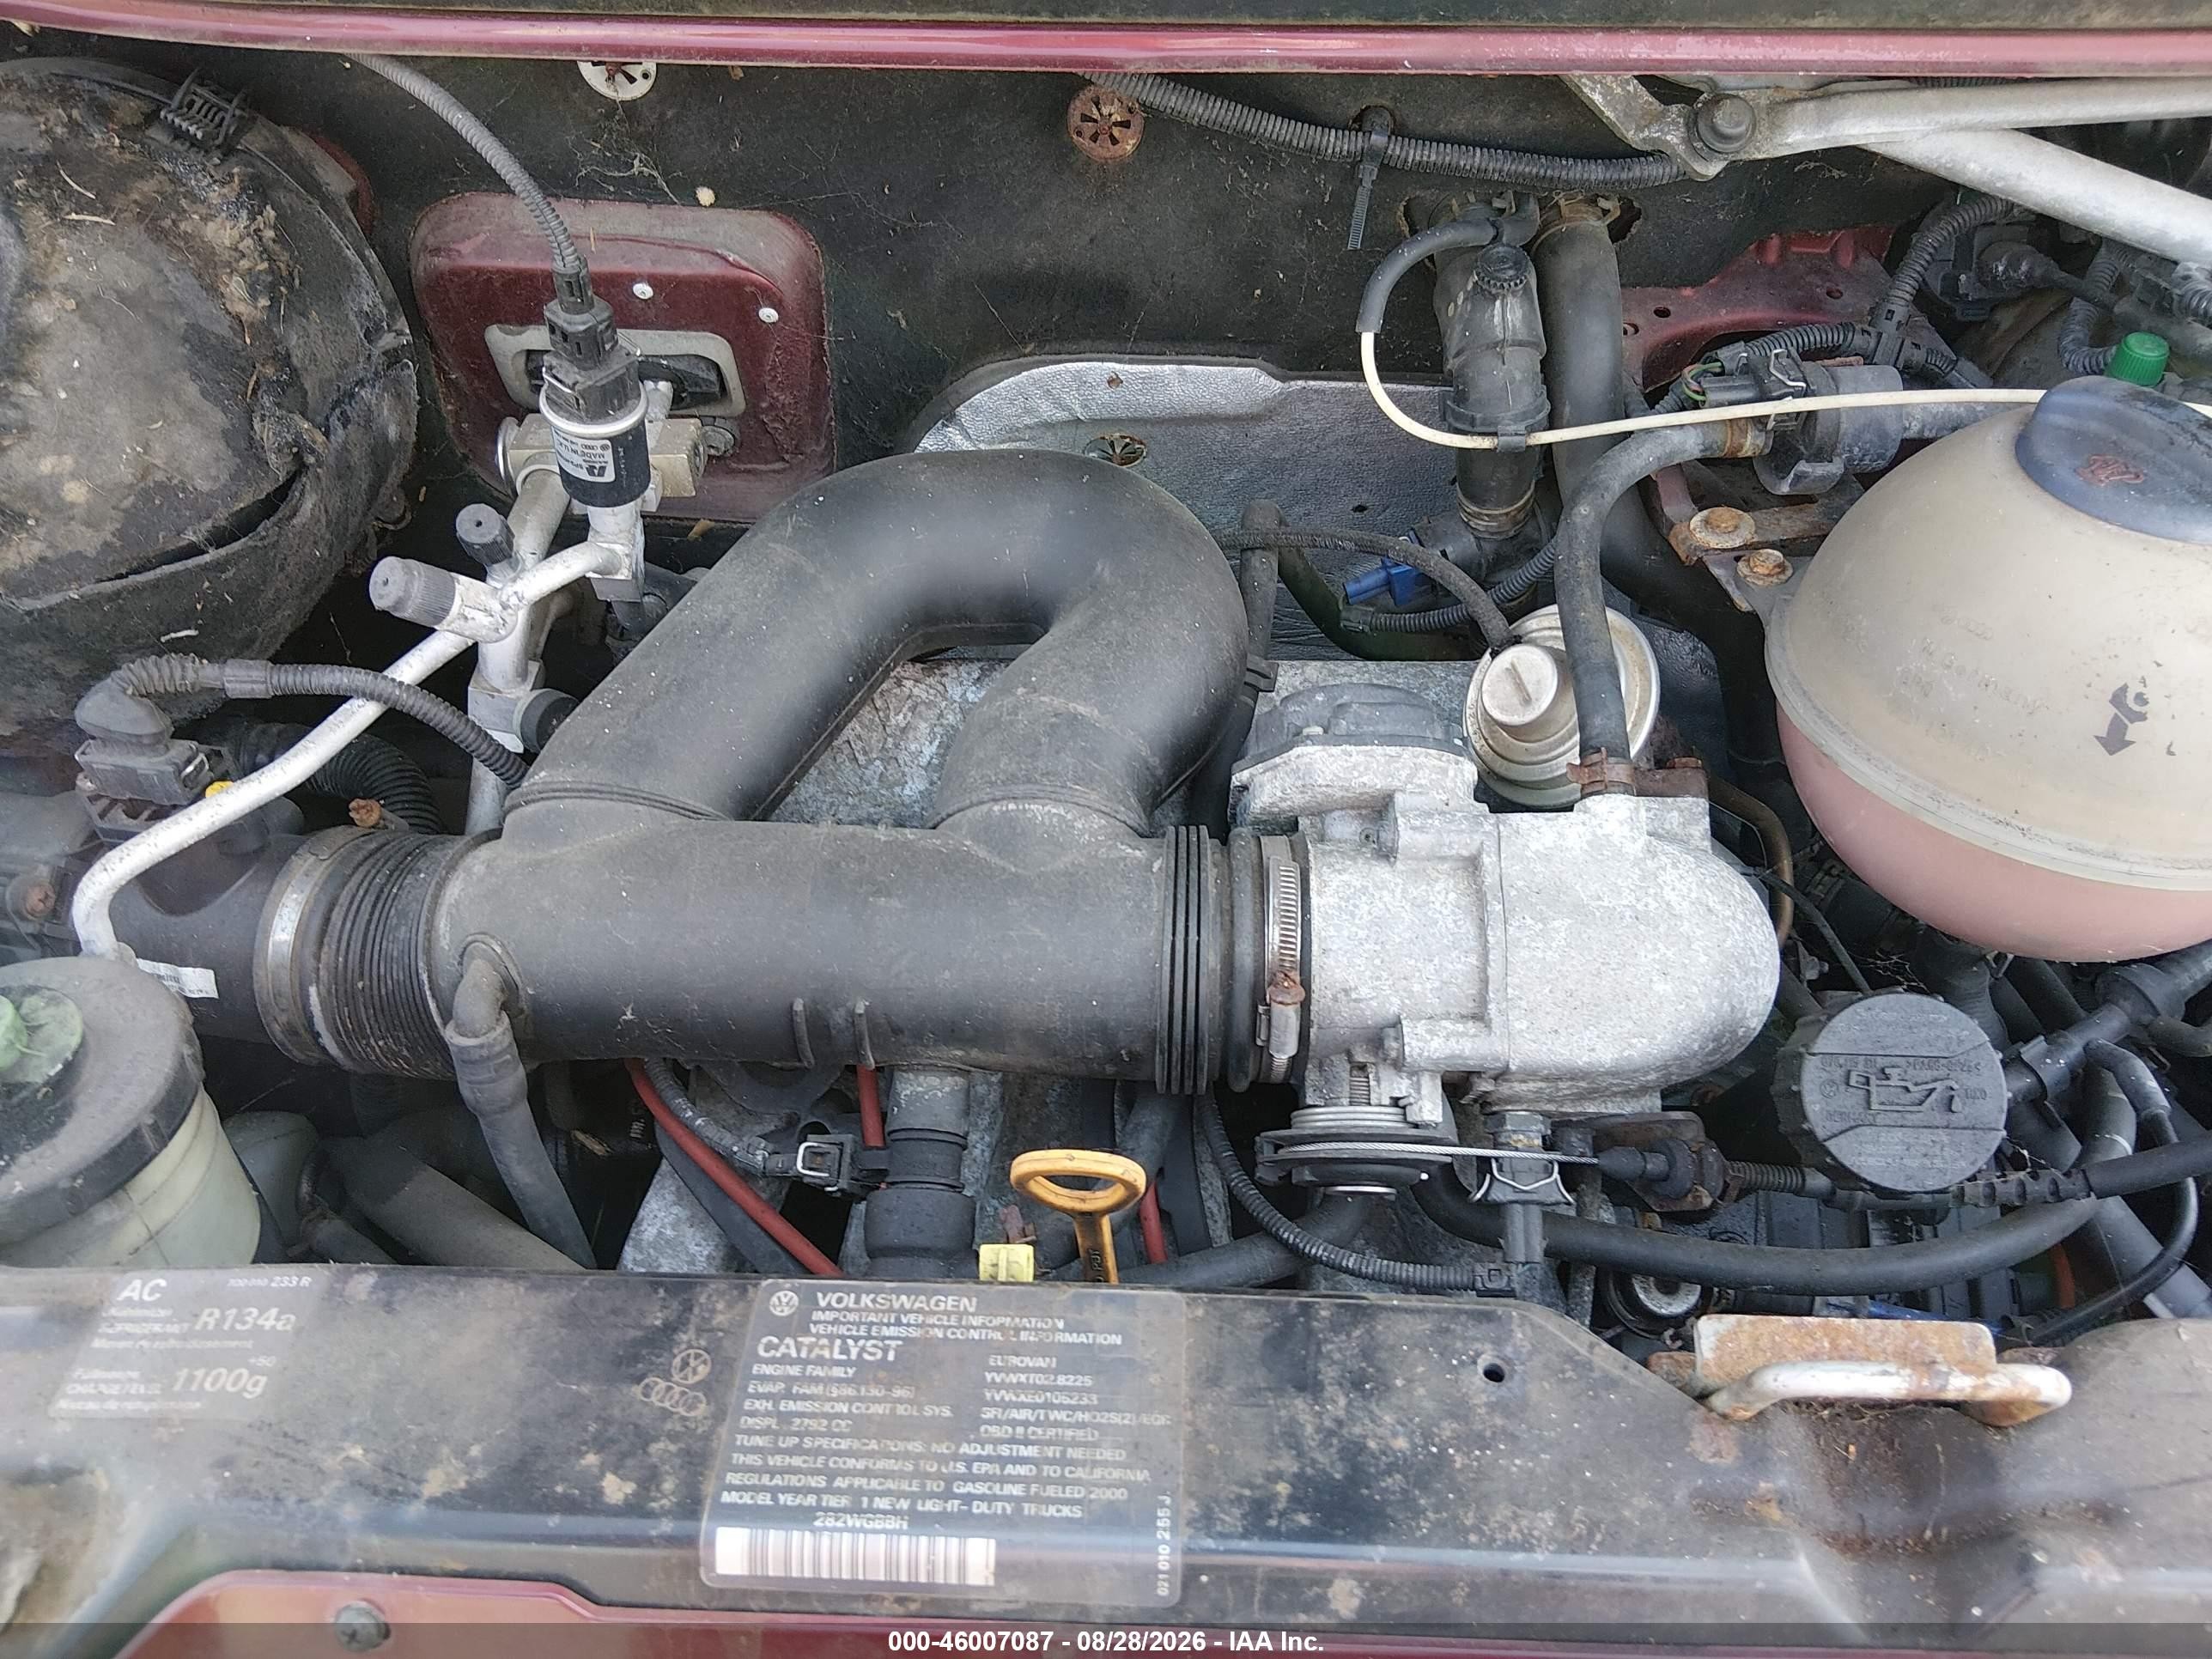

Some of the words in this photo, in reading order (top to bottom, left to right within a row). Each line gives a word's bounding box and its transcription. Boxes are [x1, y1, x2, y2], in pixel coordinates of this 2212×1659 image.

[116, 1278, 167, 1302] AC
[816, 1291, 978, 1313] VOLKSWAGEN
[194, 1307, 296, 1332] R134a
[811, 1310, 896, 1323] IMPORTANT
[809, 1323, 869, 1336] VEHICLE
[757, 1335, 902, 1362] CATALYST
[751, 1363, 804, 1376] ENGINE
[805, 1364, 857, 1378] FAMILY
[988, 1354, 1057, 1368] EUROVAN
[173, 1368, 268, 1399] 1100g
[779, 1400, 848, 1413] EMISSION
[921, 1404, 954, 1418] SYS.
[980, 1425, 1012, 1439] OBD
[1027, 1426, 1099, 1442] CERTIFIED
[735, 1434, 773, 1448] TUNE
[778, 1435, 799, 1449] UP
[932, 1442, 956, 1455] NO
[959, 1443, 1063, 1459] ADJUSTMENT
[1066, 1446, 1127, 1461] NEEDED
[732, 1453, 763, 1466] THIS
[767, 1454, 825, 1468] VEHICLE
[828, 1456, 915, 1471] CONFORMS
[919, 1460, 939, 1473] TO
[972, 1462, 1000, 1476] EPA
[1003, 1463, 1037, 1477] AND
[1042, 1464, 1061, 1478] TO
[1064, 1465, 1152, 1482] CALIFORNIA
[725, 1472, 828, 1488] REGULATIONS
[833, 1475, 921, 1492] APPLICABLE
[925, 1479, 945, 1492] TO
[953, 1480, 1026, 1497] GASOLINE
[1030, 1484, 1085, 1498] FUELED
[1089, 1486, 1128, 1500] 2000
[720, 1490, 774, 1504] MODEL
[777, 1492, 817, 1506] YEAR
[820, 1494, 851, 1507] TIER
[860, 1496, 868, 1509] 1
[872, 1497, 910, 1510] NEW
[972, 1501, 1014, 1515] DUTY
[1021, 1503, 1084, 1518] TRUCKS
[1157, 1508, 1171, 1540] 255
[1158, 1544, 1170, 1571] 010
[1157, 1573, 1170, 1596] 021
